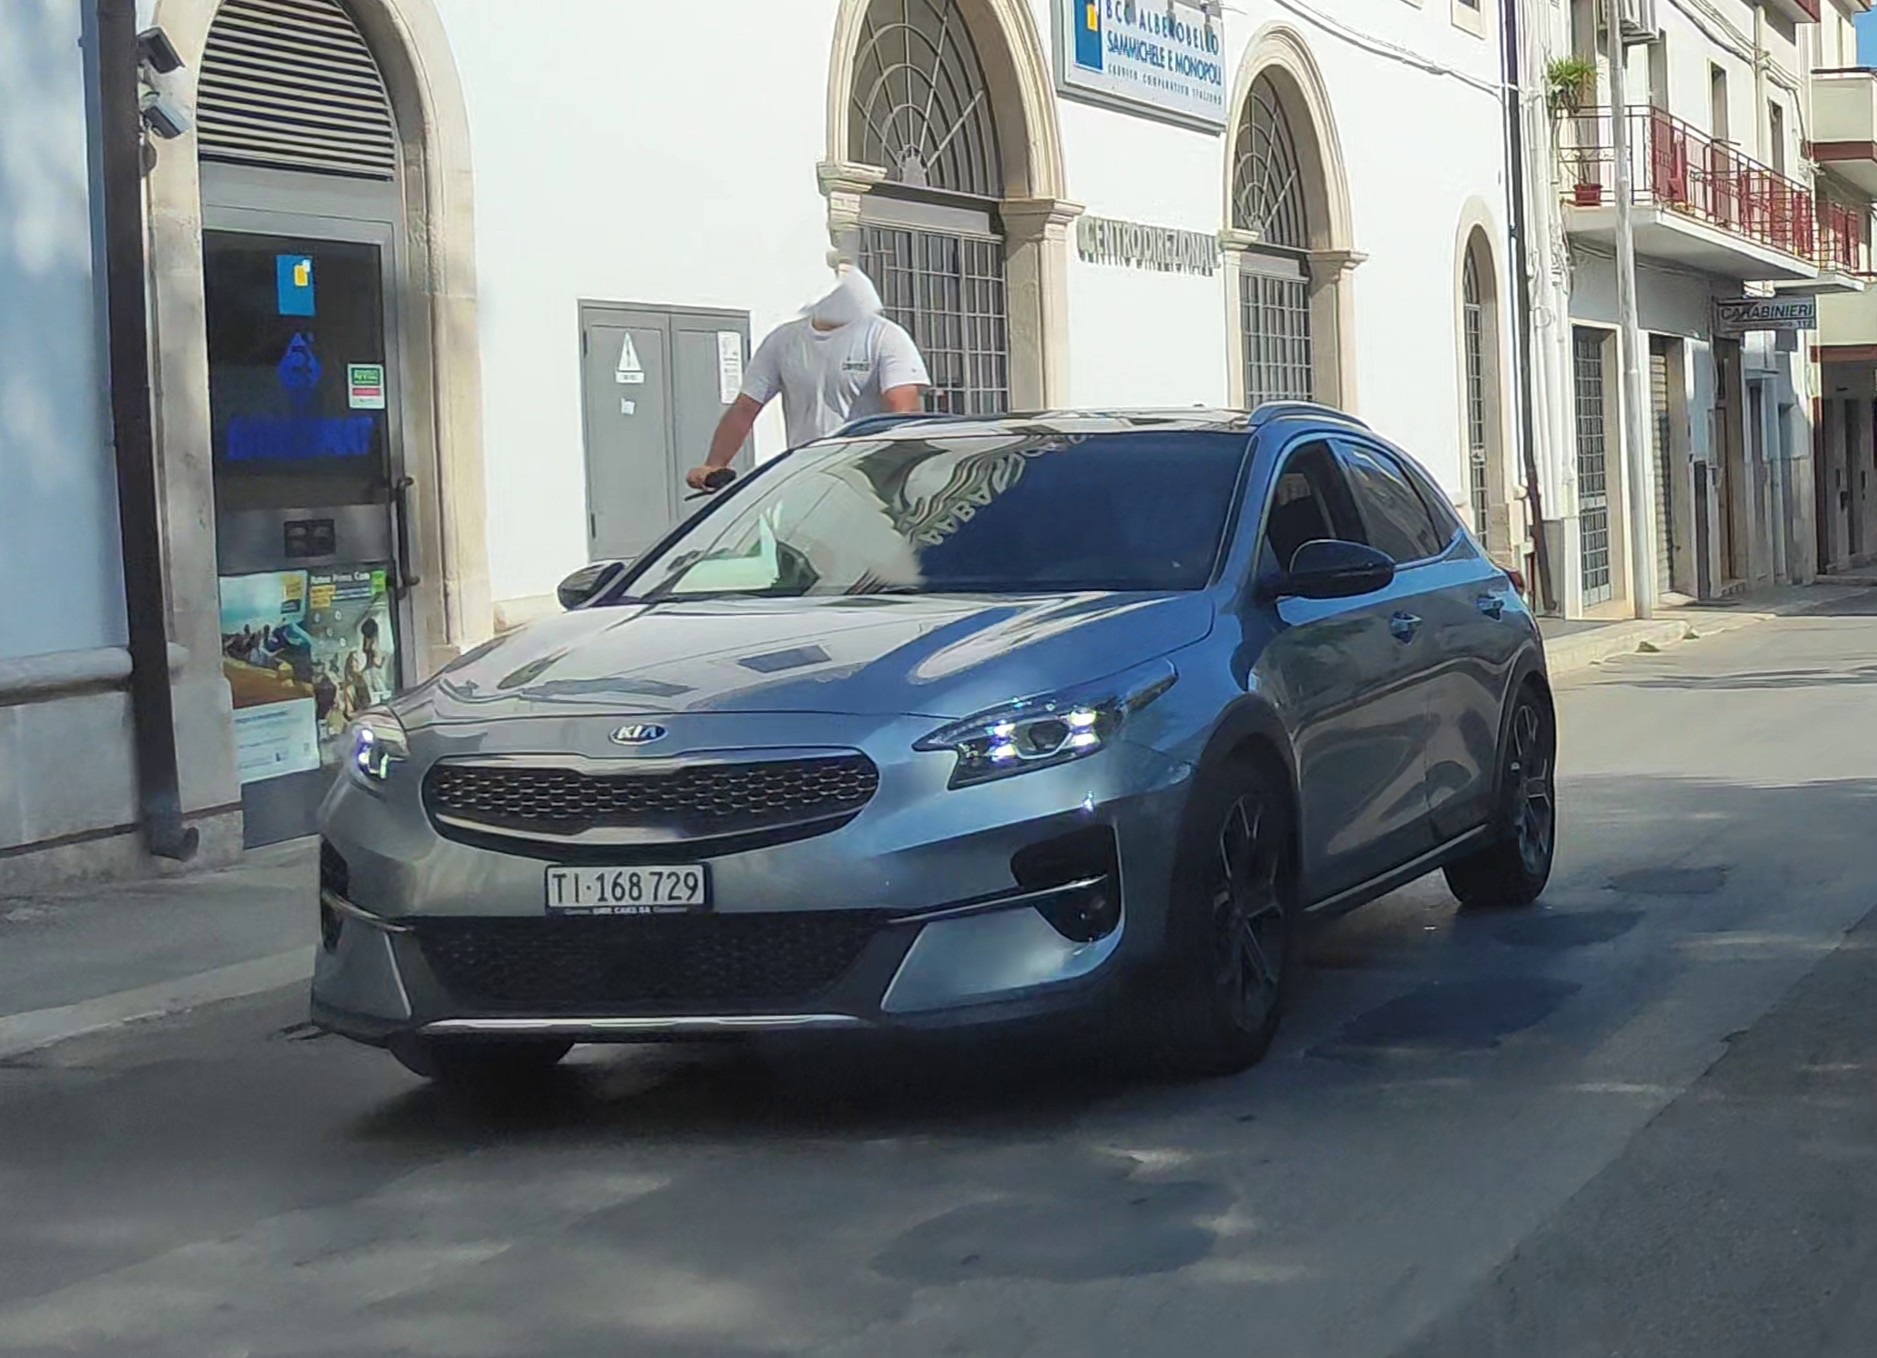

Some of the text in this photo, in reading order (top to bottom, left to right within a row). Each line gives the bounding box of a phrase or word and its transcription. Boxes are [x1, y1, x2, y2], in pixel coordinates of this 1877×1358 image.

[1106, 0, 1135, 25] BCC
[1175, 52, 1221, 86] MONOPOLI
[1721, 304, 1812, 320] CARABINIERI
[618, 725, 657, 739] KIA
